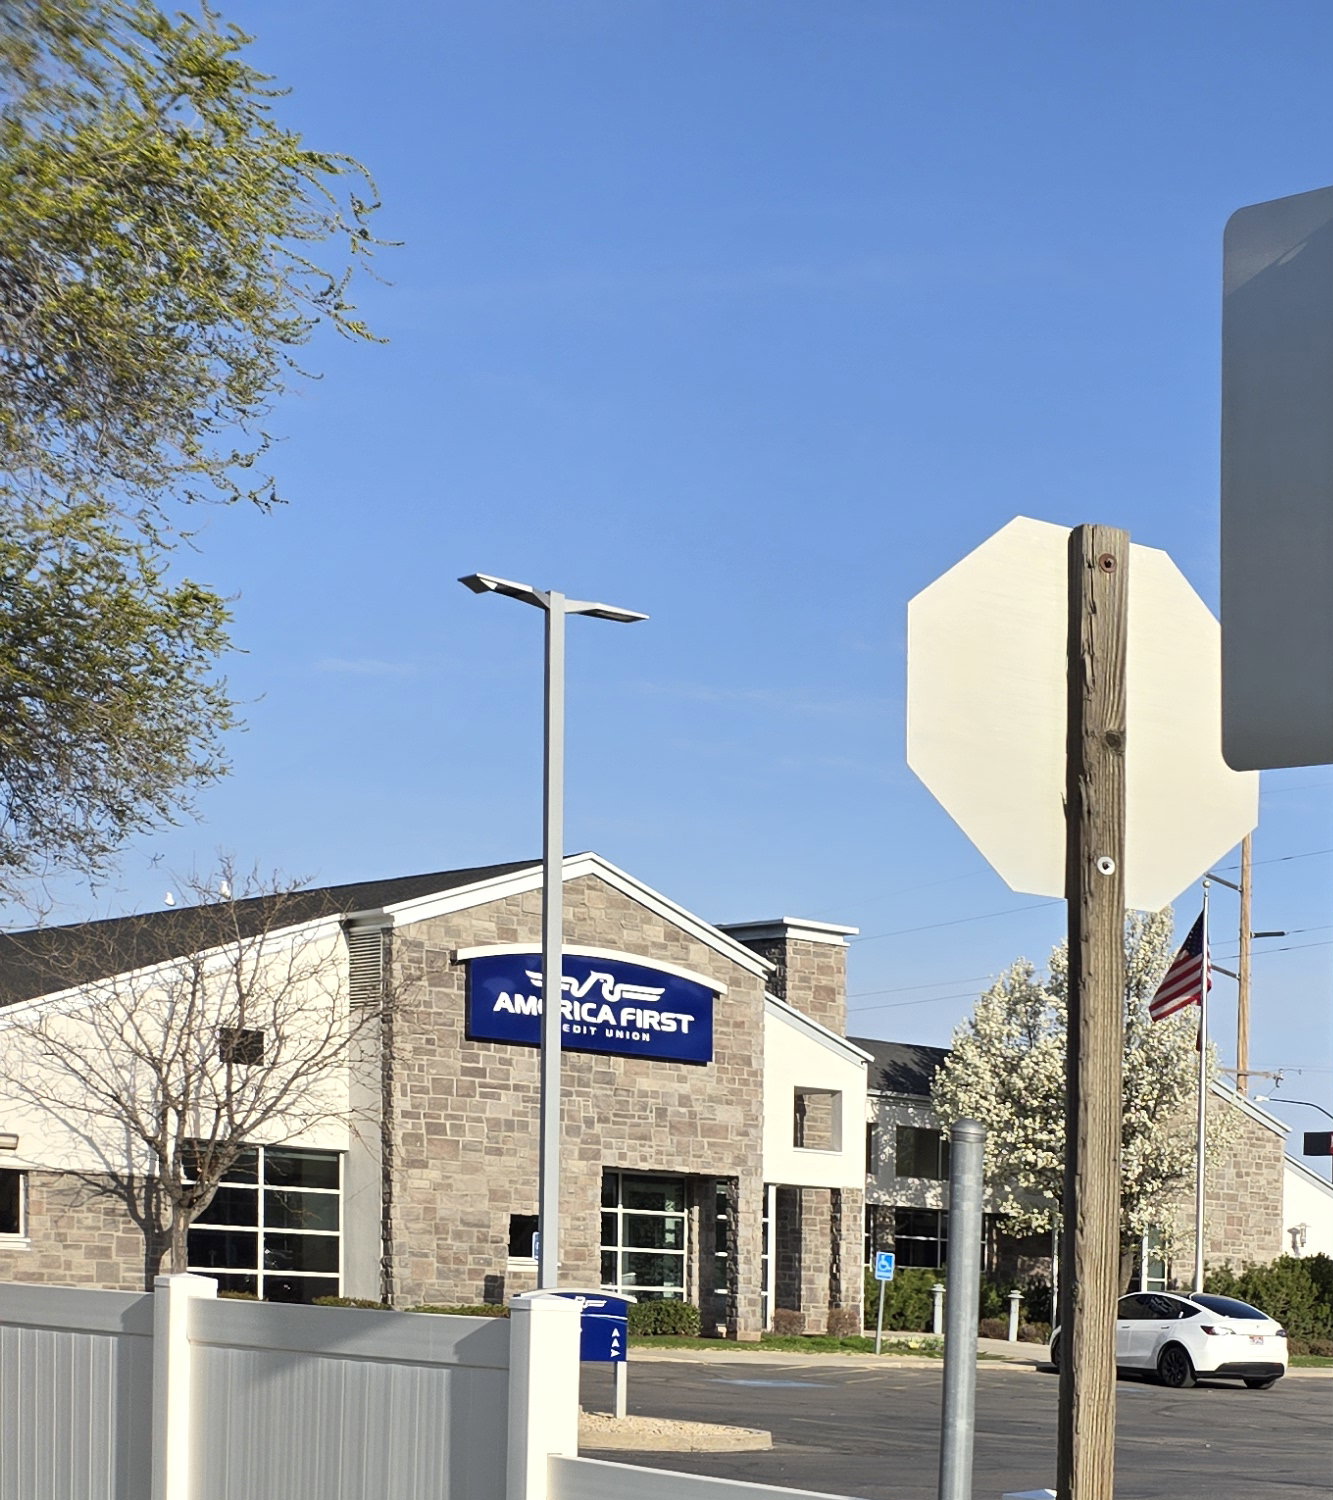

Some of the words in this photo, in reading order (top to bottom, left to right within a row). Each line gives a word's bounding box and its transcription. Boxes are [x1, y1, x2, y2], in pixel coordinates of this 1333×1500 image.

[493, 991, 617, 1026] AMRICA
[620, 1007, 695, 1034] FIRST
[605, 1028, 651, 1042] UNION
